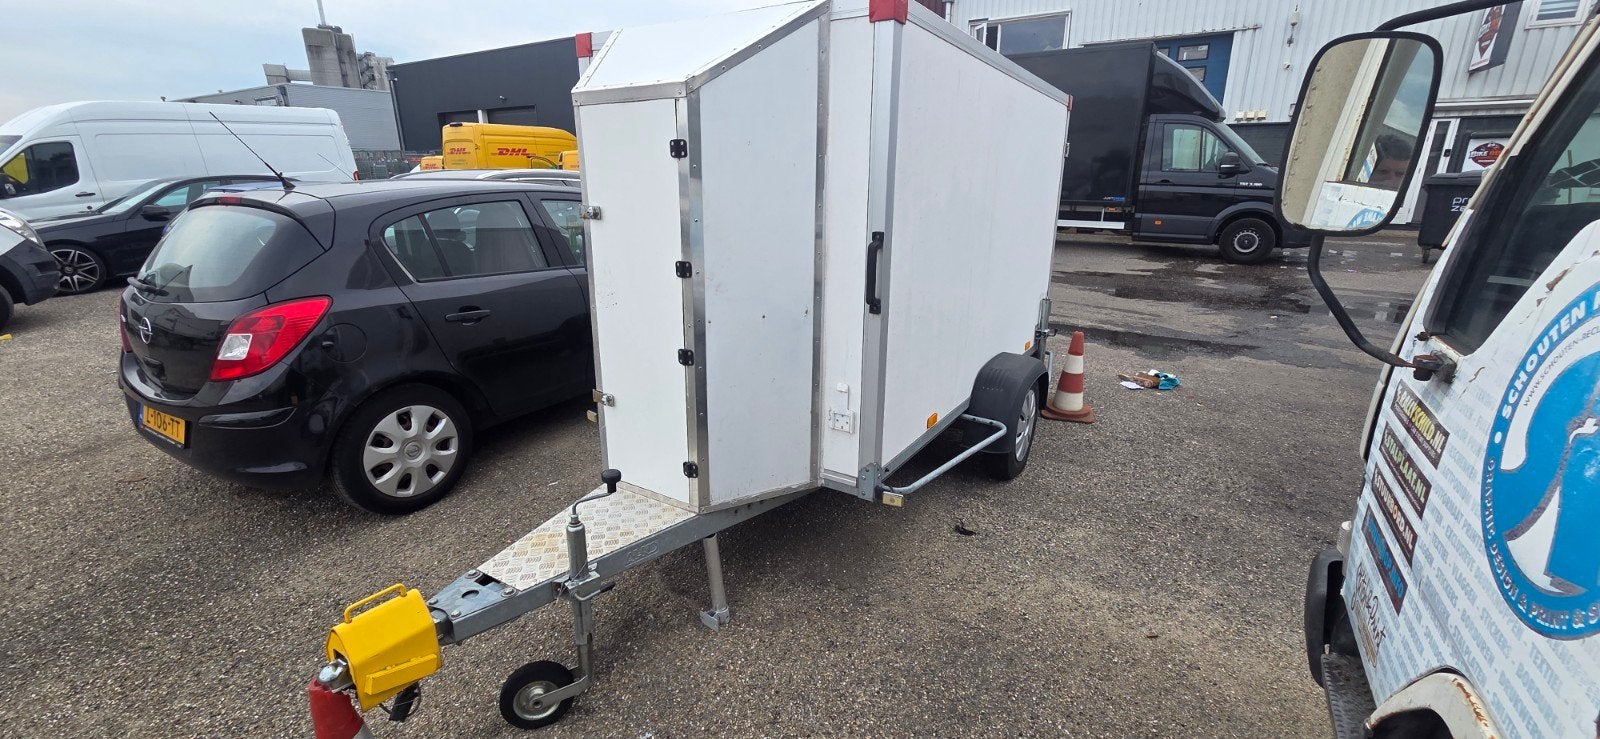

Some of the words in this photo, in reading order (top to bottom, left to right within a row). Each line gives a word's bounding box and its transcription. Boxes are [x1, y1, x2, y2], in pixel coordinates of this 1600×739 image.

[497, 147, 528, 156] DHL
[1501, 300, 1586, 419] SCHOUTEN
[146, 406, 181, 438] L-106-TT
[1399, 390, 1446, 454] RALLYSCHILD.NL
[1384, 435, 1427, 504] STALPLAAT.NL
[1490, 541, 1519, 601] DESIGN
